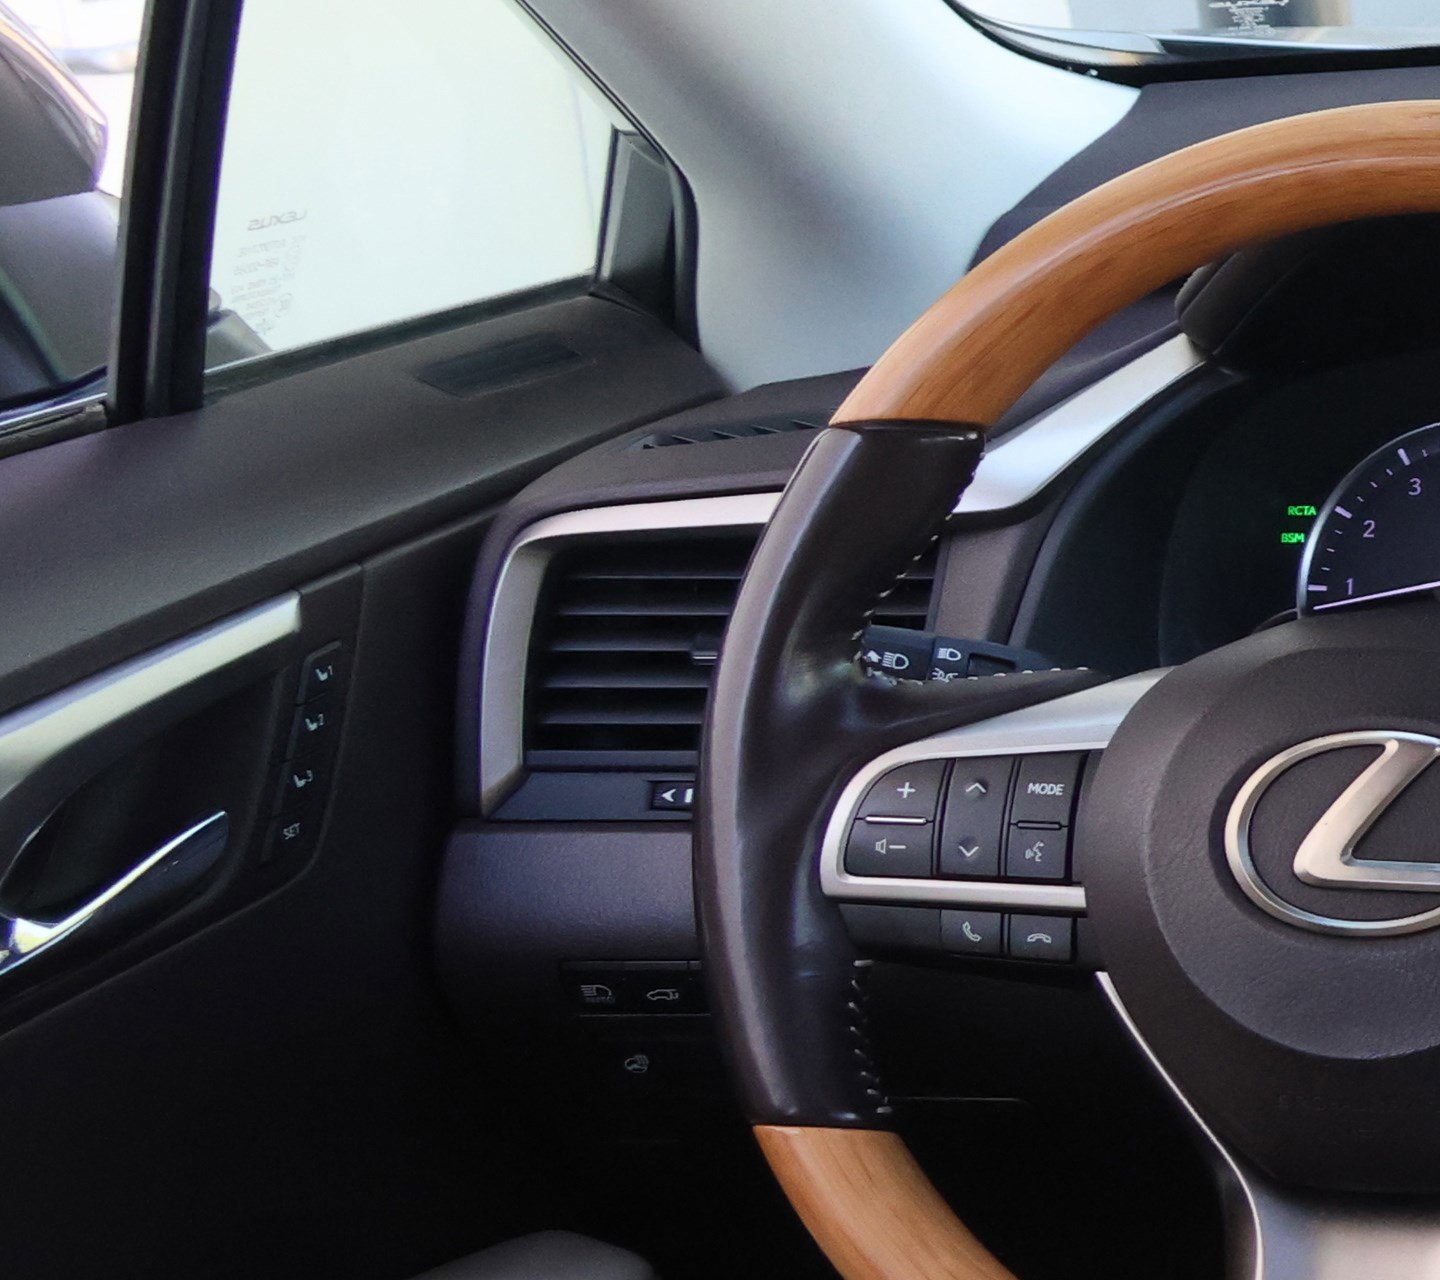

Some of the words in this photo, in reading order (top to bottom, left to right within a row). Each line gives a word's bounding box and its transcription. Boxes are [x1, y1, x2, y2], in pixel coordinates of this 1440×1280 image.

[1408, 478, 1422, 496] 3
[1287, 506, 1317, 516] RCTA
[1281, 533, 1305, 543] BSM
[1362, 520, 1375, 538] 2
[1346, 577, 1353, 595] 1
[1027, 782, 1065, 796] MODE
[282, 822, 301, 840] SET
